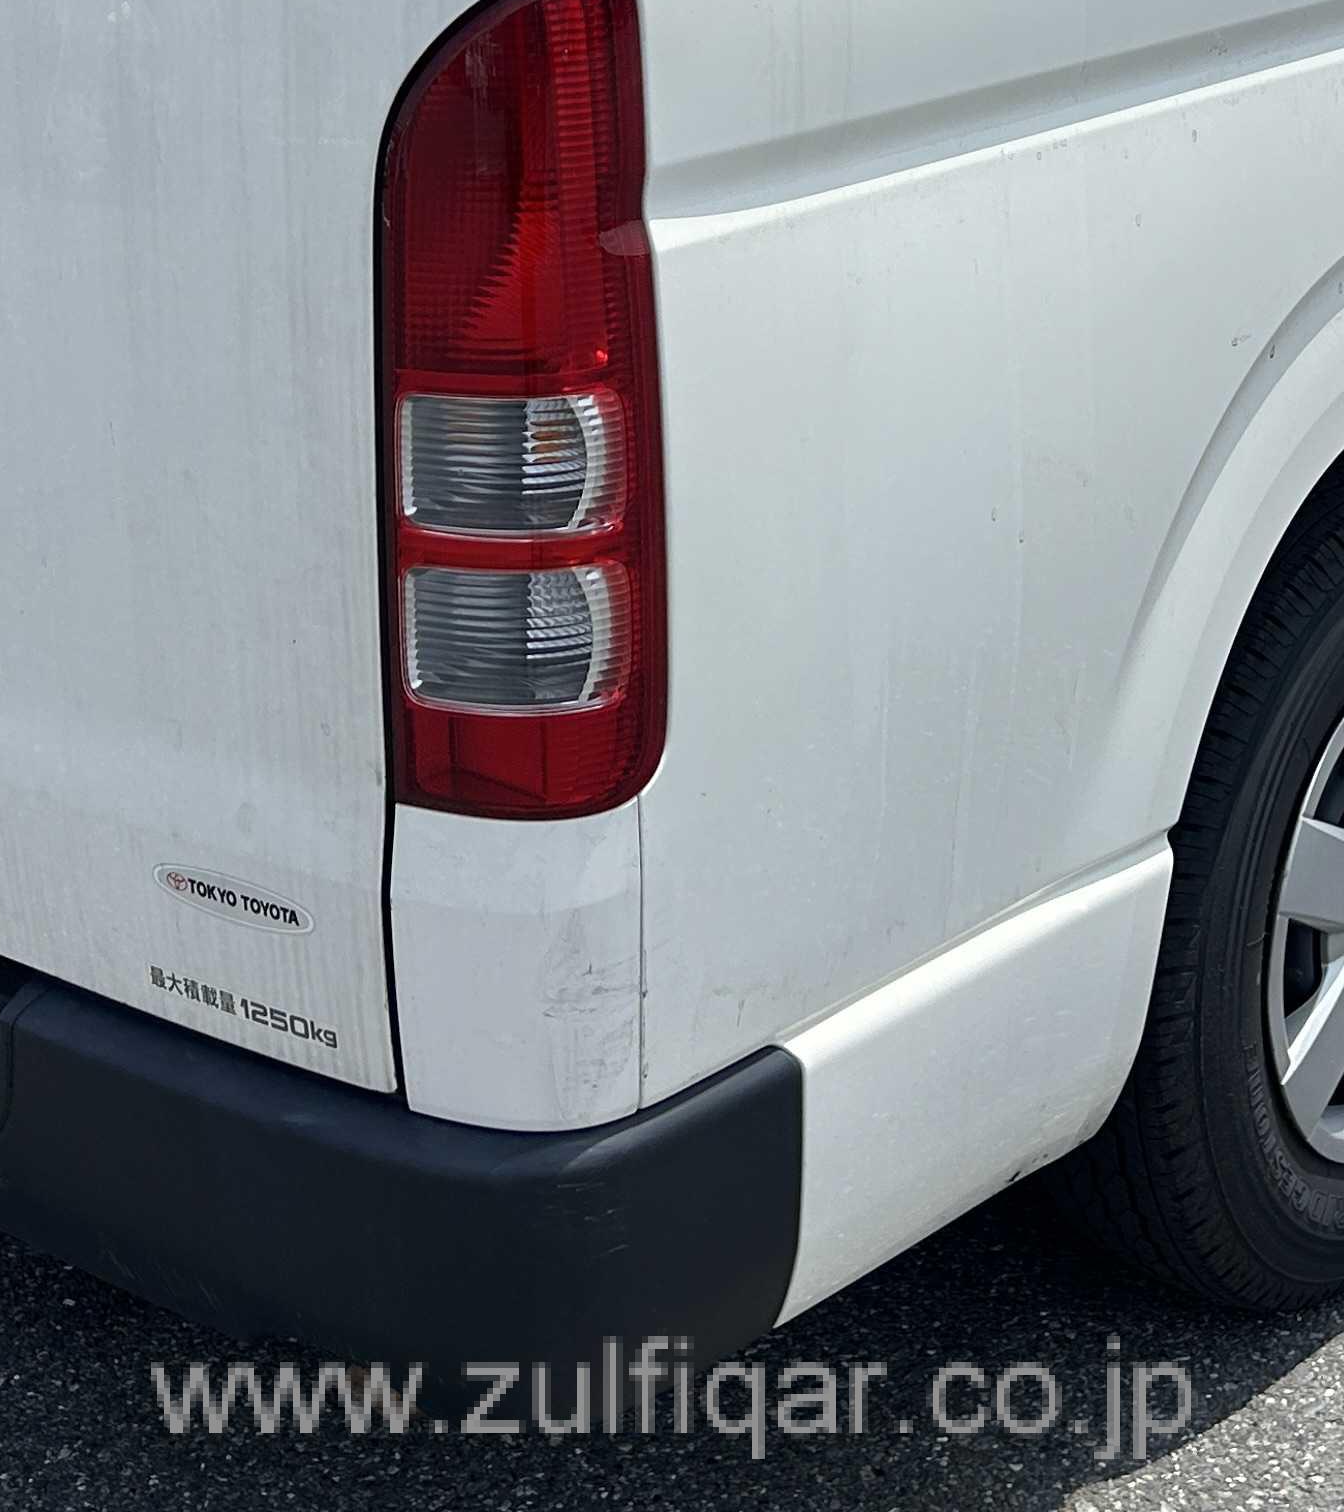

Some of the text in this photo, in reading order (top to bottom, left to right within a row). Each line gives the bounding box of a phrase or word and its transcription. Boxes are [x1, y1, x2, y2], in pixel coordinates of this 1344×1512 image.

[188, 878, 300, 926] TOKYO TOYOTA
[150, 965, 337, 1048] 最大積載量 1250kg
